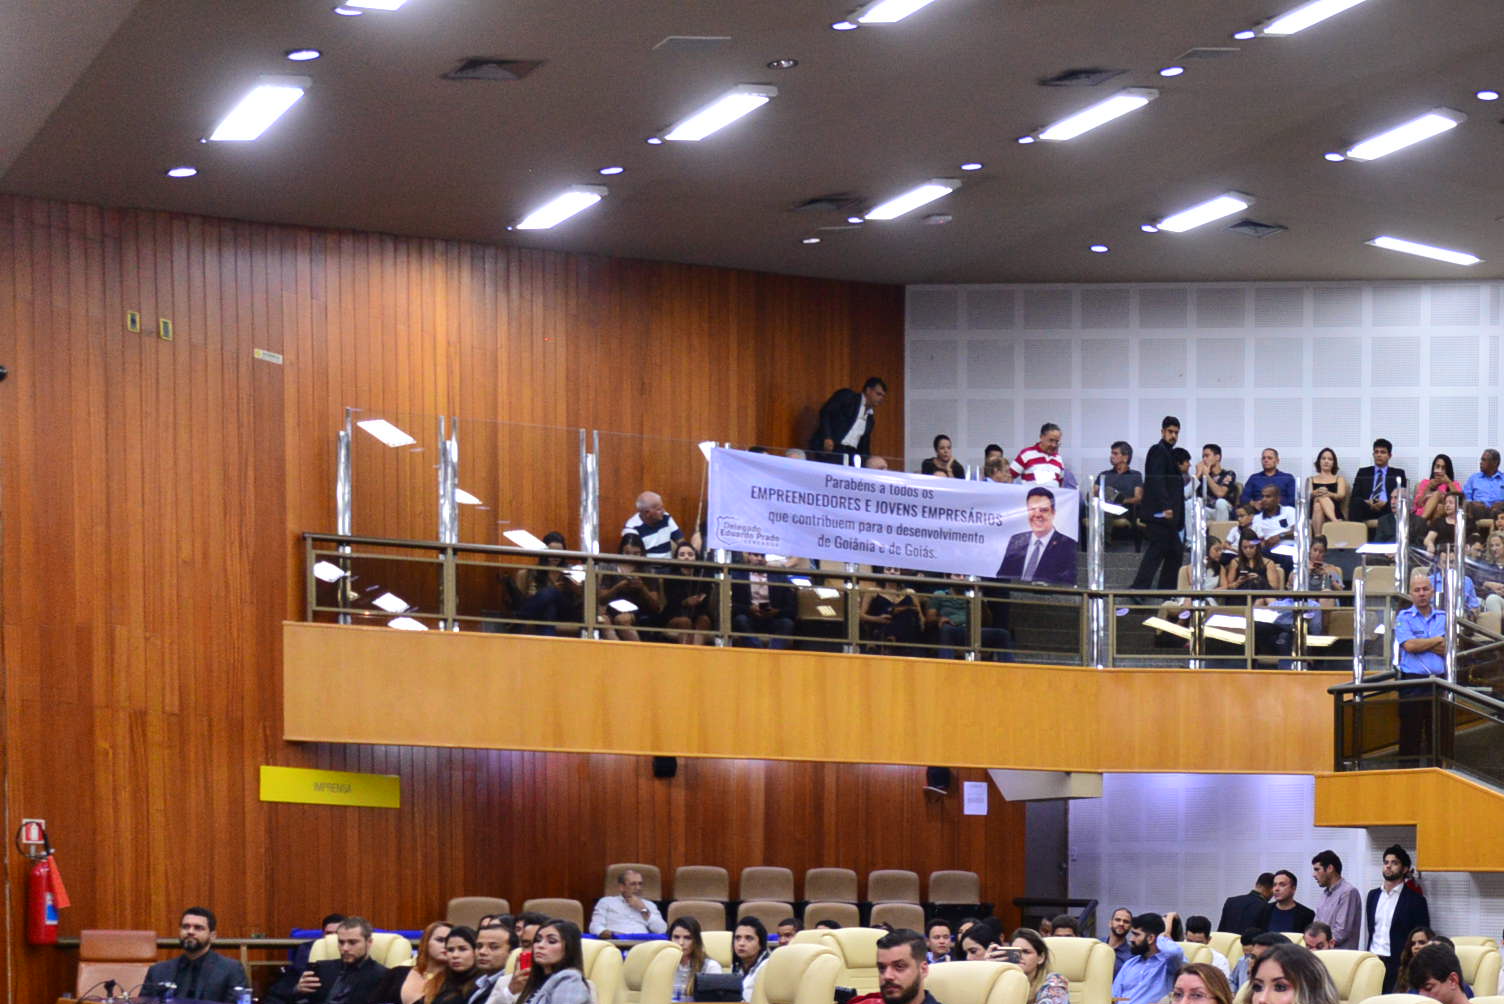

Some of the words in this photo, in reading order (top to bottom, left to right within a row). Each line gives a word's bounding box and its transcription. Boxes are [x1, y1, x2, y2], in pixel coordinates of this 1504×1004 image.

[825, 474, 876, 493] Parabéns
[879, 484, 886, 494] a
[890, 484, 919, 498] todos
[922, 489, 934, 499] os
[751, 485, 861, 511] EMPREENDEDORES
[865, 499, 872, 512] E
[875, 500, 918, 518] JOVENS
[921, 506, 1003, 527] EMPRESÁRIOS
[720, 528, 754, 540] Eduardo
[768, 511, 789, 524] que
[792, 514, 856, 530] contribuem
[858, 521, 883, 534] para
[886, 524, 893, 535] o
[896, 523, 985, 544] desenvolvimento
[818, 535, 831, 548] de
[834, 535, 876, 553] Goiânia
[888, 542, 901, 555] de
[904, 543, 938, 559] Goiás.
